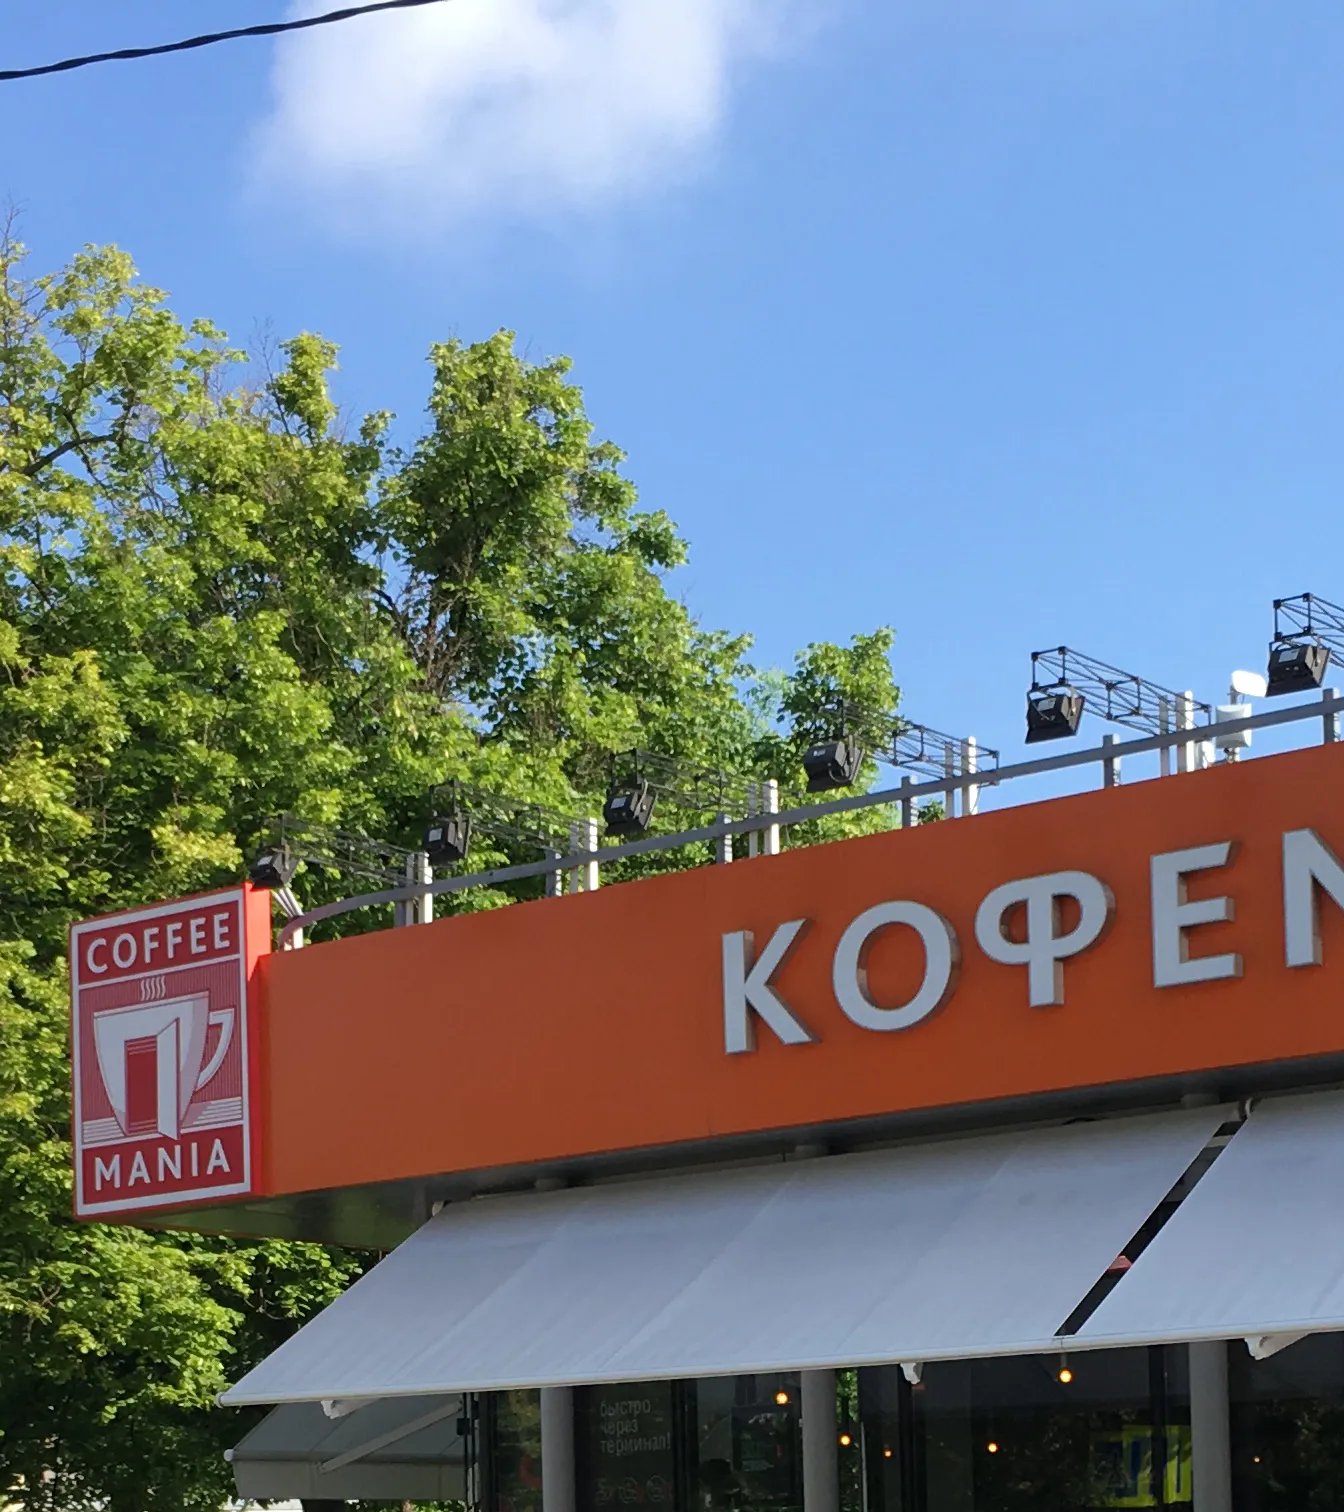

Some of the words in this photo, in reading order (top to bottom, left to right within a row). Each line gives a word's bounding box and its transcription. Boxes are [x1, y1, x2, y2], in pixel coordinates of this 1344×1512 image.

[86, 911, 231, 974] COFFEE
[94, 1138, 231, 1192] MANIA
[600, 1399, 651, 1417] быстро
[600, 1419, 639, 1438] через
[600, 1432, 672, 1456] терминал!
